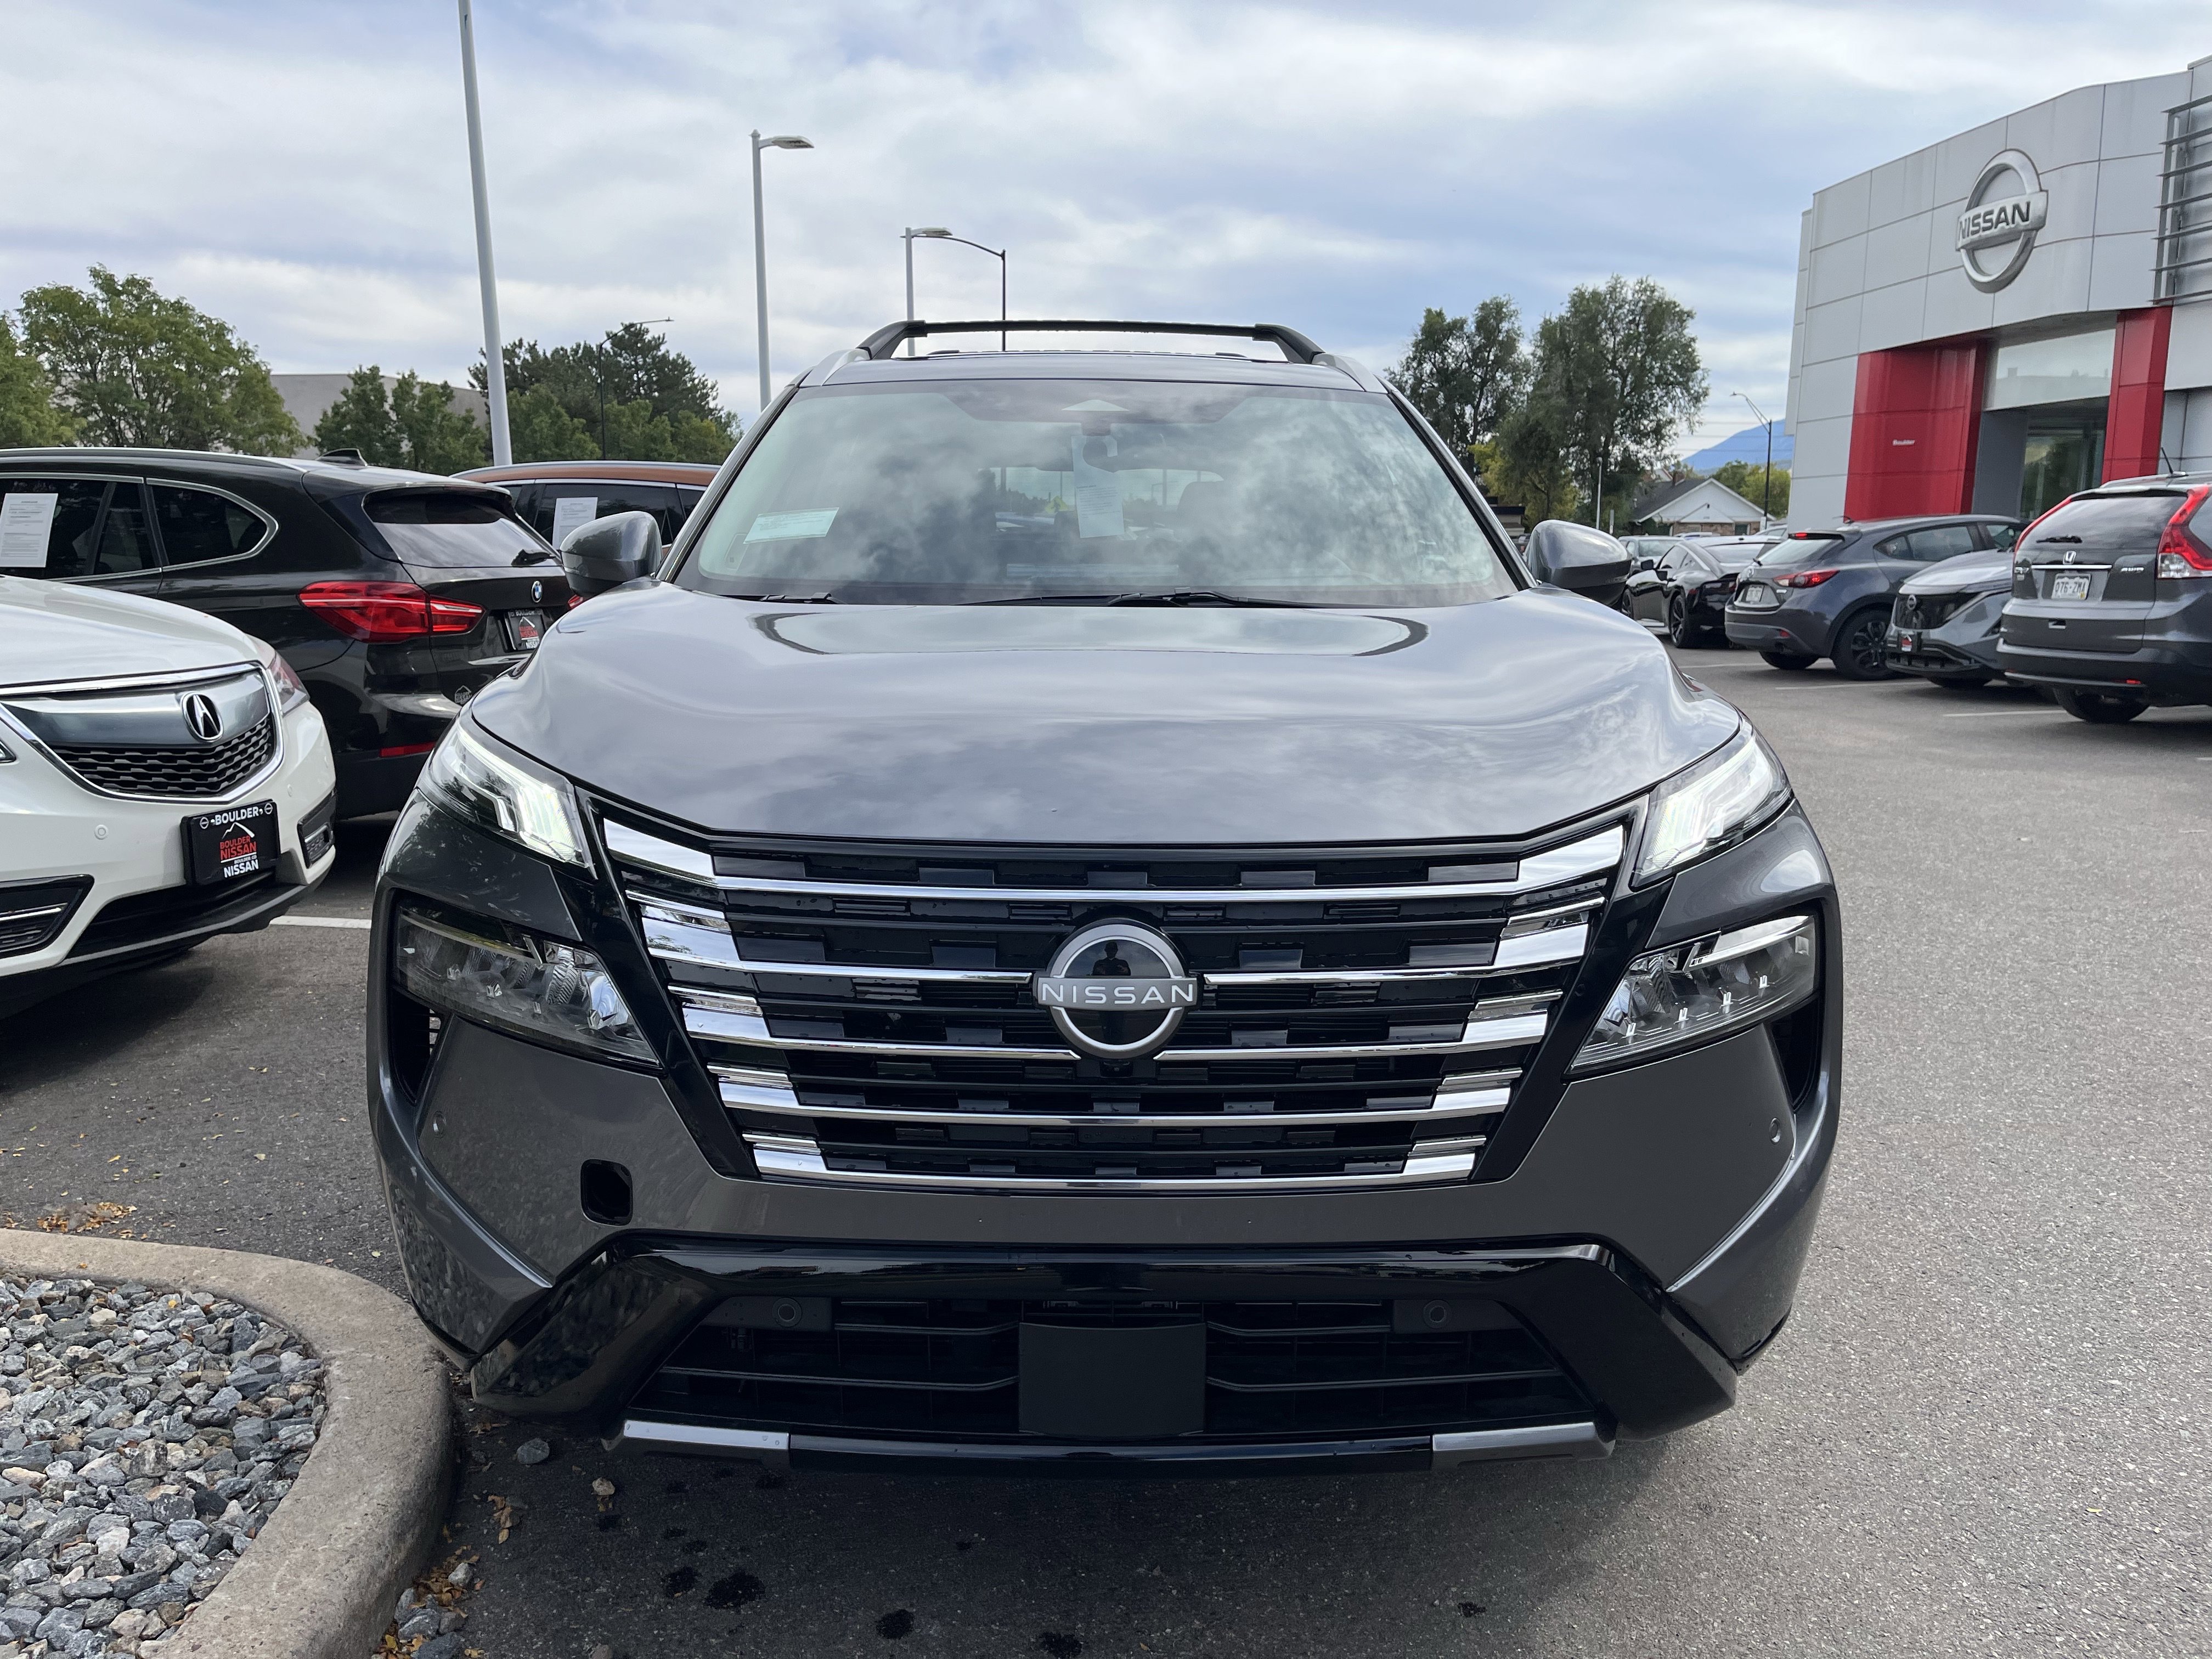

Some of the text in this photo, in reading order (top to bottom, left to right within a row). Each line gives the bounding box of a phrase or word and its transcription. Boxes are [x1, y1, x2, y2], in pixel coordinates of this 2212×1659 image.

[1957, 201, 2032, 241] NISSAN
[215, 806, 259, 826] BOULDER
[220, 835, 251, 849] BOULDER
[221, 841, 257, 860] NISSAN
[223, 859, 259, 878] NISSAN
[1042, 983, 1193, 1005] NISSAN
